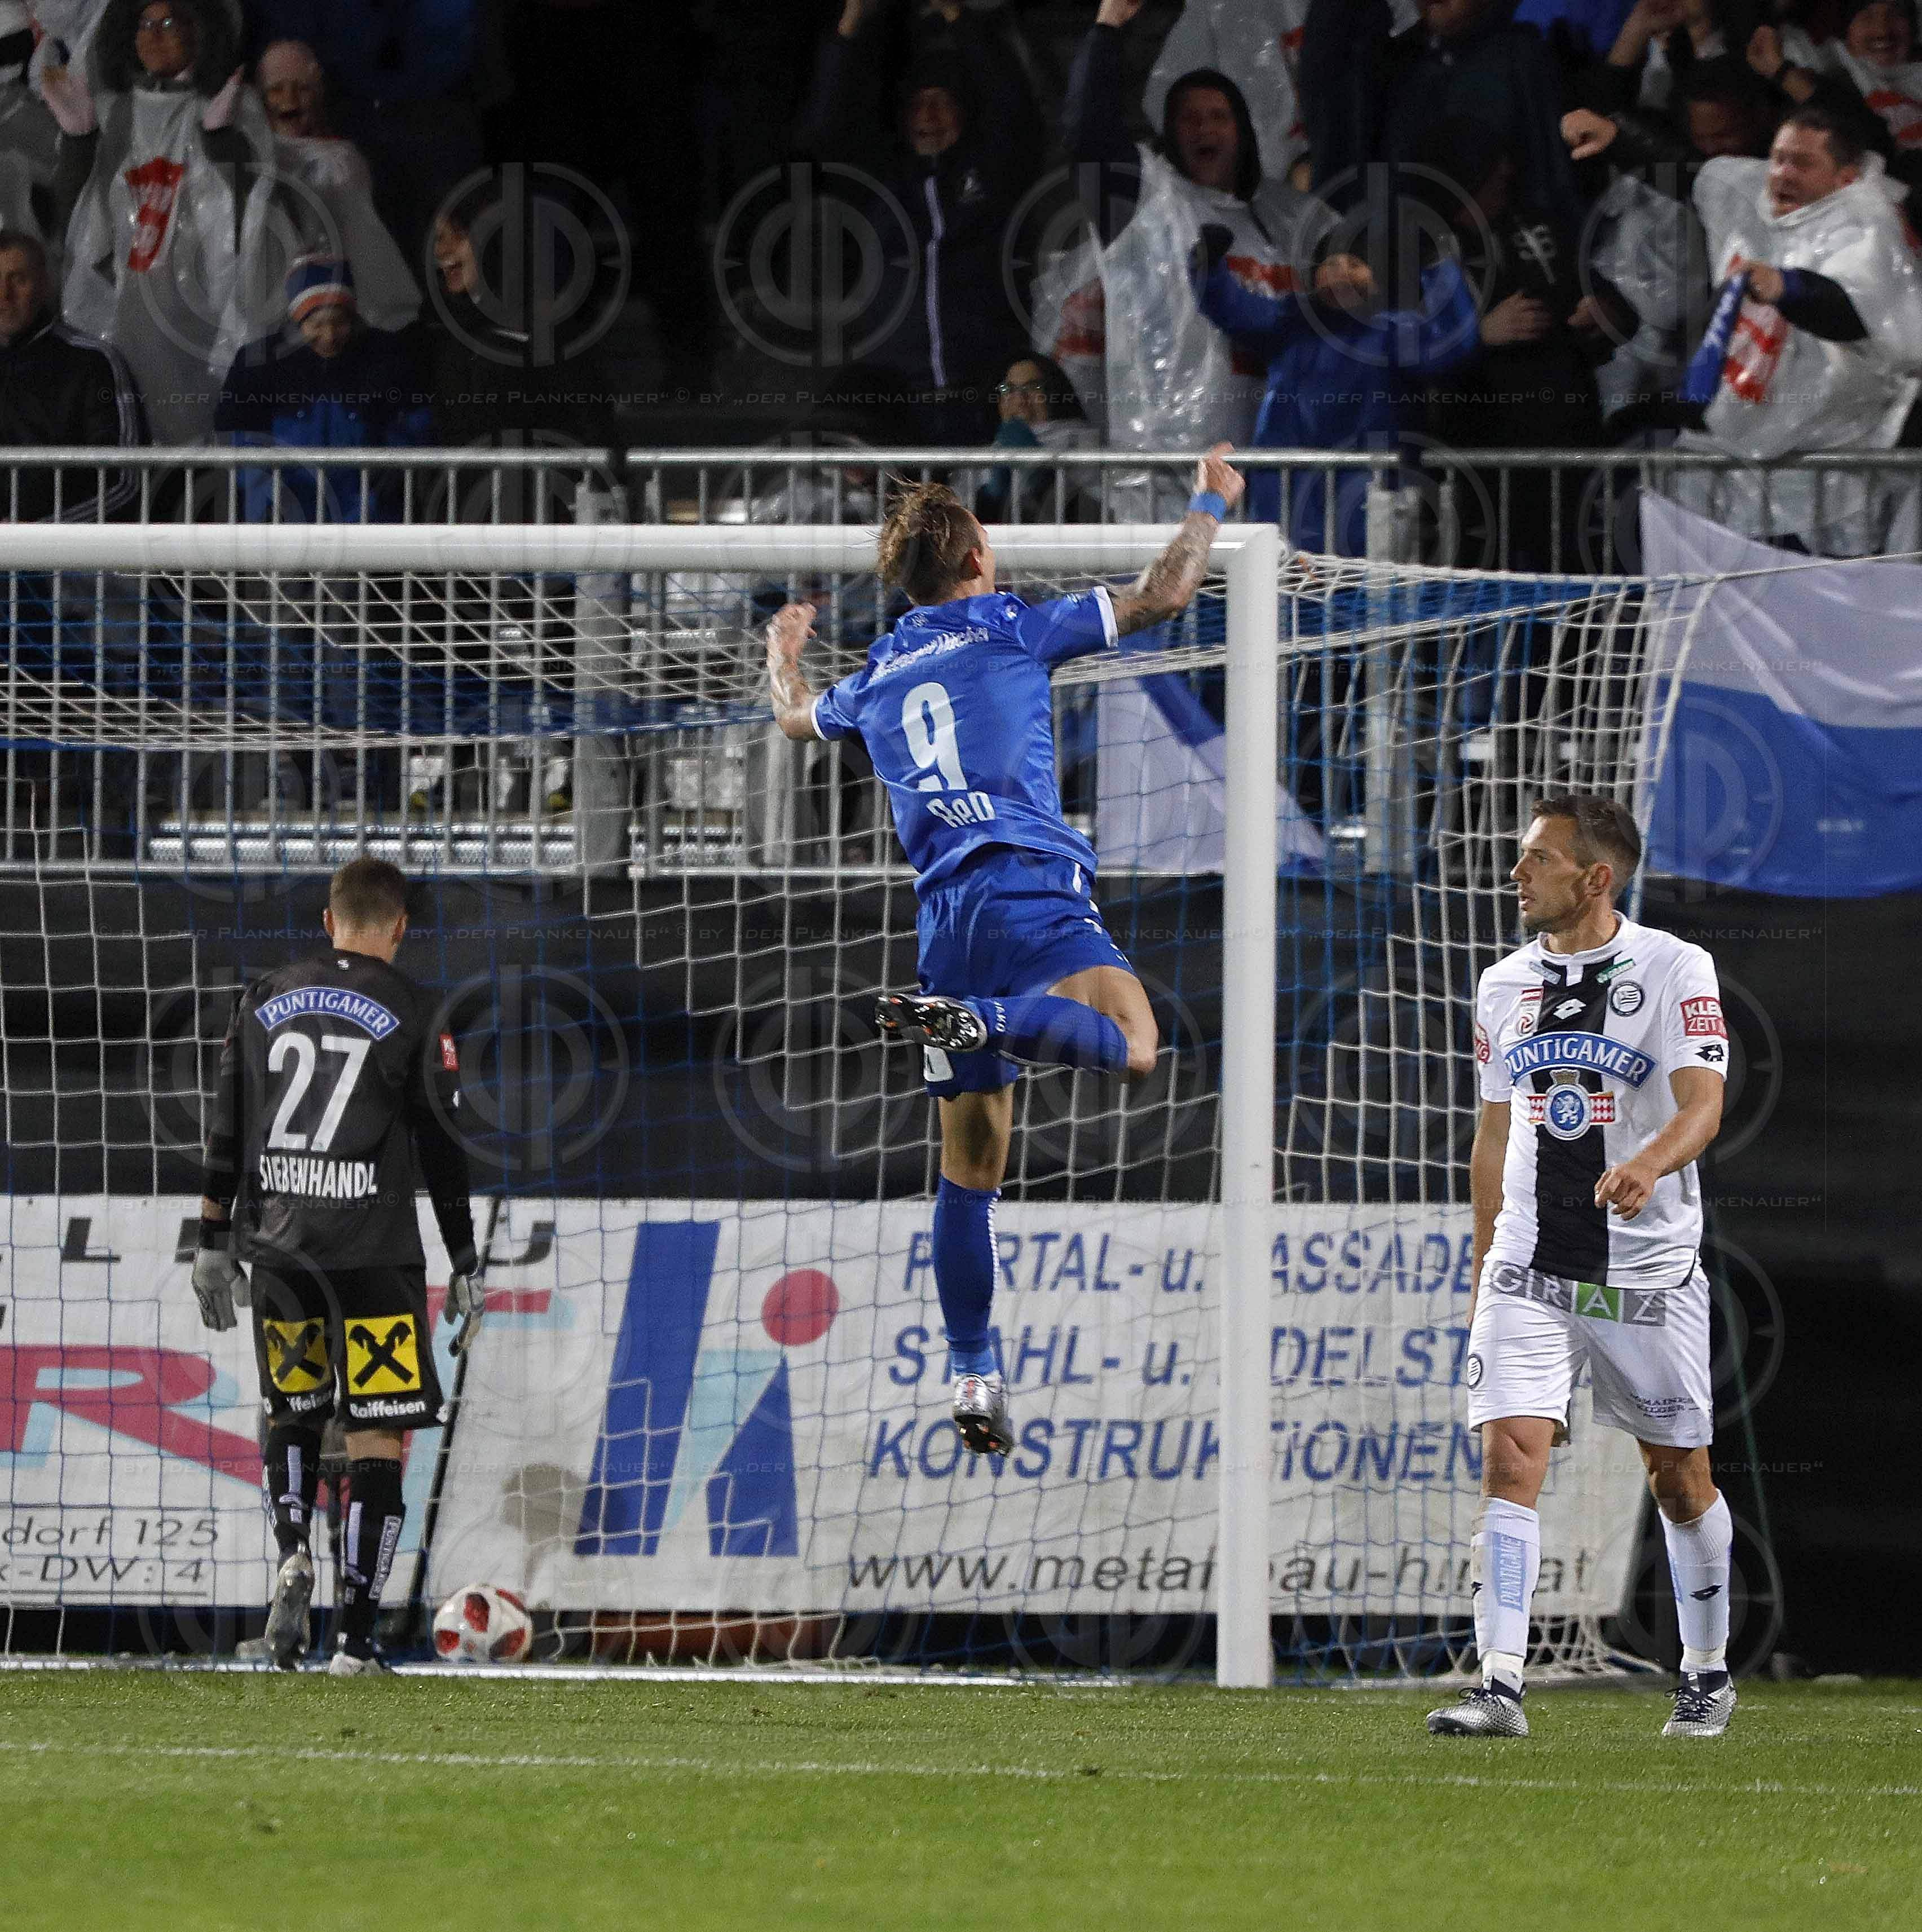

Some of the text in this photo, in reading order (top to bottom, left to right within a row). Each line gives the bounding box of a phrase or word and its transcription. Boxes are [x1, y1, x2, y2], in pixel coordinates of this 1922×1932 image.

[902, 682, 968, 790] 9
[263, 991, 390, 1033] PUNTIGAMER
[267, 1031, 371, 1152] 27
[259, 1154, 377, 1199] SIEBENHANDL
[903, 1231, 1474, 1293] PRTAL- u. ASSADE
[889, 1325, 1121, 1386] SHL-
[1141, 1342, 1190, 1386] u.
[869, 1417, 1483, 1482] KOSTRUKIONEN
[134, 1519, 219, 1546] 125
[175, 1558, 206, 1582] 4
